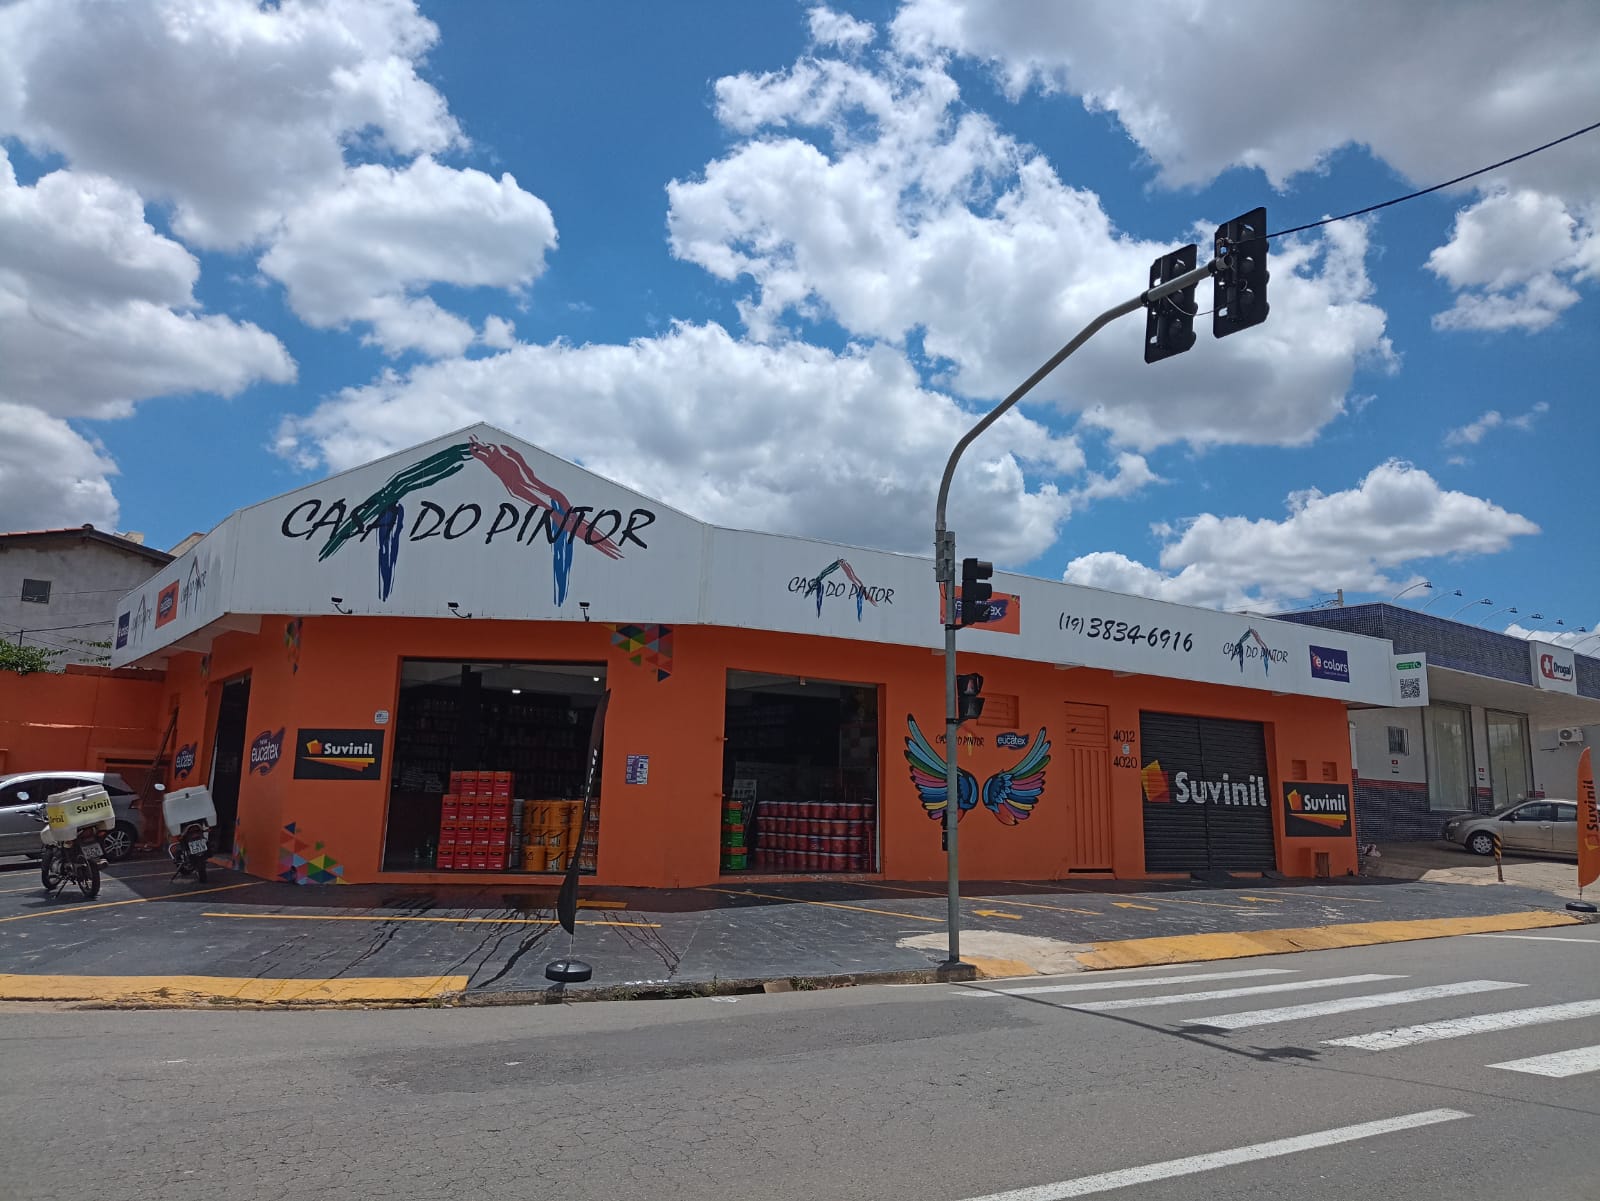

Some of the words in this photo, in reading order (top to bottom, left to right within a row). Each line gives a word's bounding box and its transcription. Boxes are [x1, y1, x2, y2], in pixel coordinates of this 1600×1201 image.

[281, 498, 401, 542] CASA
[410, 501, 482, 541] DO
[485, 502, 656, 549] PINTOR
[788, 577, 820, 596] CASA
[826, 581, 846, 597] DO
[849, 584, 895, 605] PINTOR
[1059, 612, 1084, 634] (19)
[1087, 618, 1193, 652] 3834-6916
[1246, 645, 1259, 658] DO
[1260, 647, 1289, 663] PINTOR
[1323, 659, 1349, 673] colors
[997, 735, 1027, 746] eucatex
[1113, 730, 1135, 743] 4012
[251, 742, 279, 762] eucatex
[324, 742, 373, 755] Suvinil
[1113, 756, 1138, 769] 4020
[1175, 771, 1268, 807] Suvinil
[76, 798, 111, 814] Suvinil
[1304, 794, 1347, 811] Suvinil
[1583, 780, 1599, 832] Suvinil
